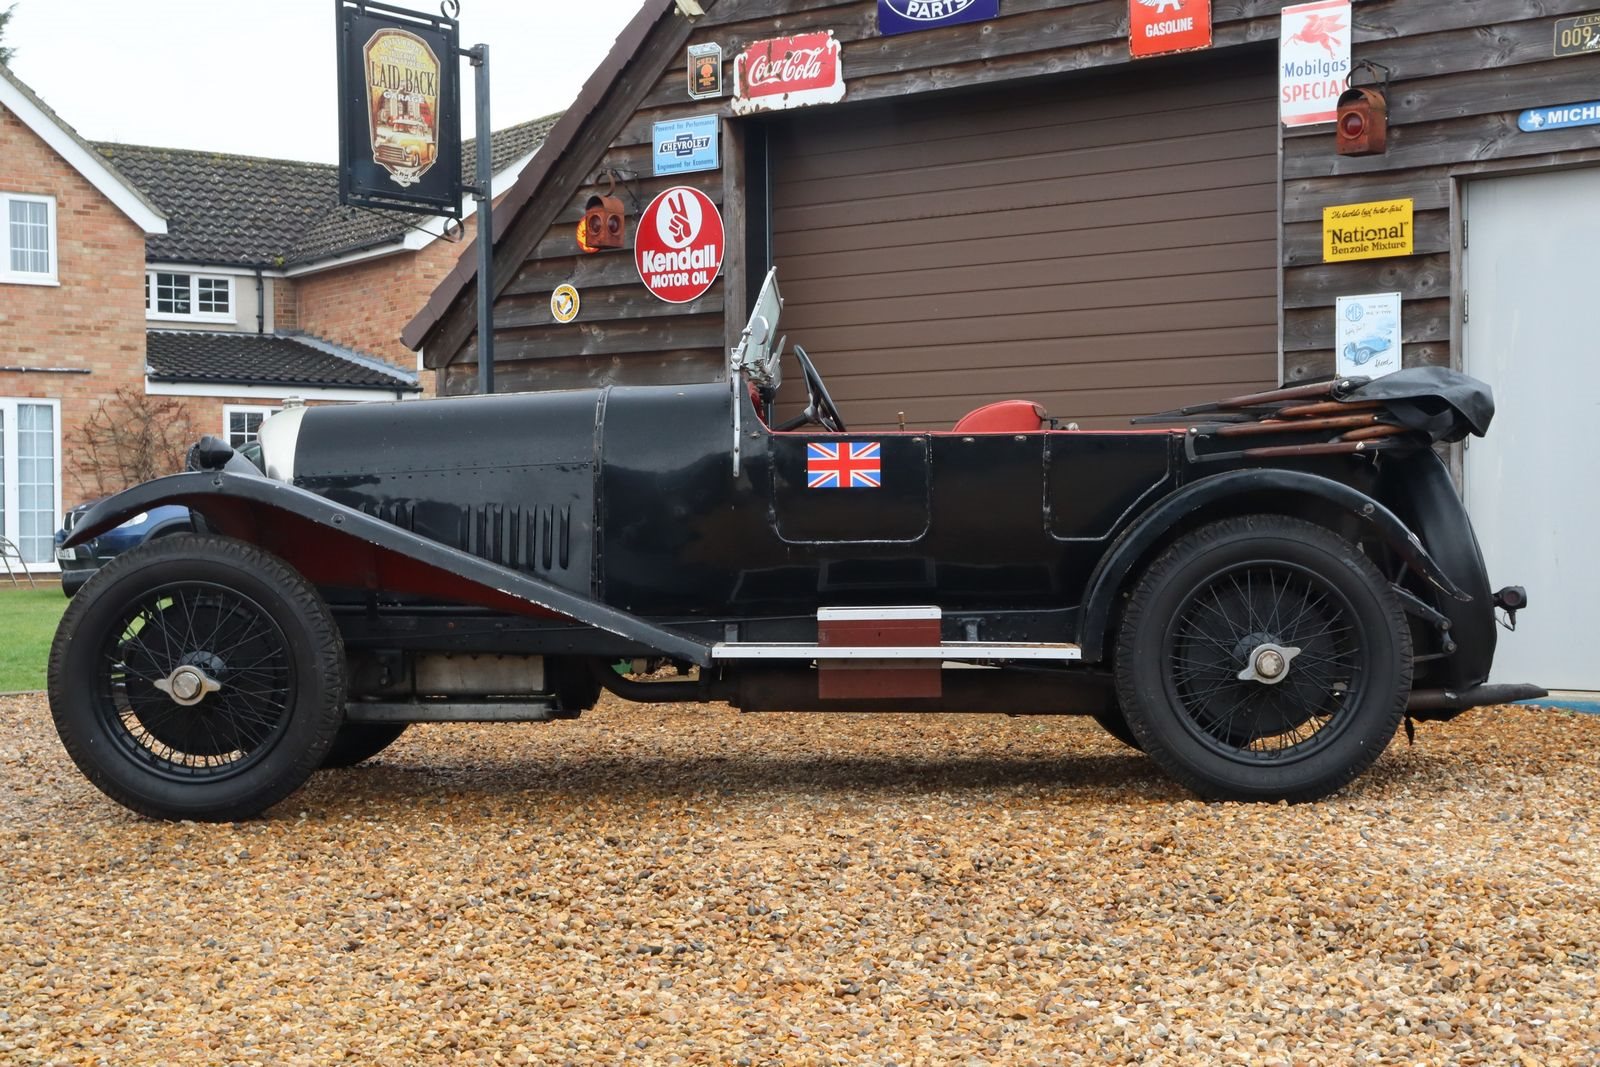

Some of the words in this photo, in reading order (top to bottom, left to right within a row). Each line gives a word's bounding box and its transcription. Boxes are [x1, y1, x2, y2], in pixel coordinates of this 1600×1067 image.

[1145, 17, 1193, 37] GASOLINE
[1562, 26, 1591, 48] 009
[696, 57, 717, 68] SHELL
[748, 47, 824, 86] Coca-Cola
[1284, 59, 1347, 78] Mobilgas
[383, 91, 425, 103] GARAGE
[662, 138, 707, 152] CHEVROLET
[1331, 244, 1369, 255] Benzole
[1372, 241, 1406, 251] Mixture
[642, 244, 716, 273] Kendall
[651, 272, 689, 288] MOTOR
[692, 270, 709, 286] OIL
